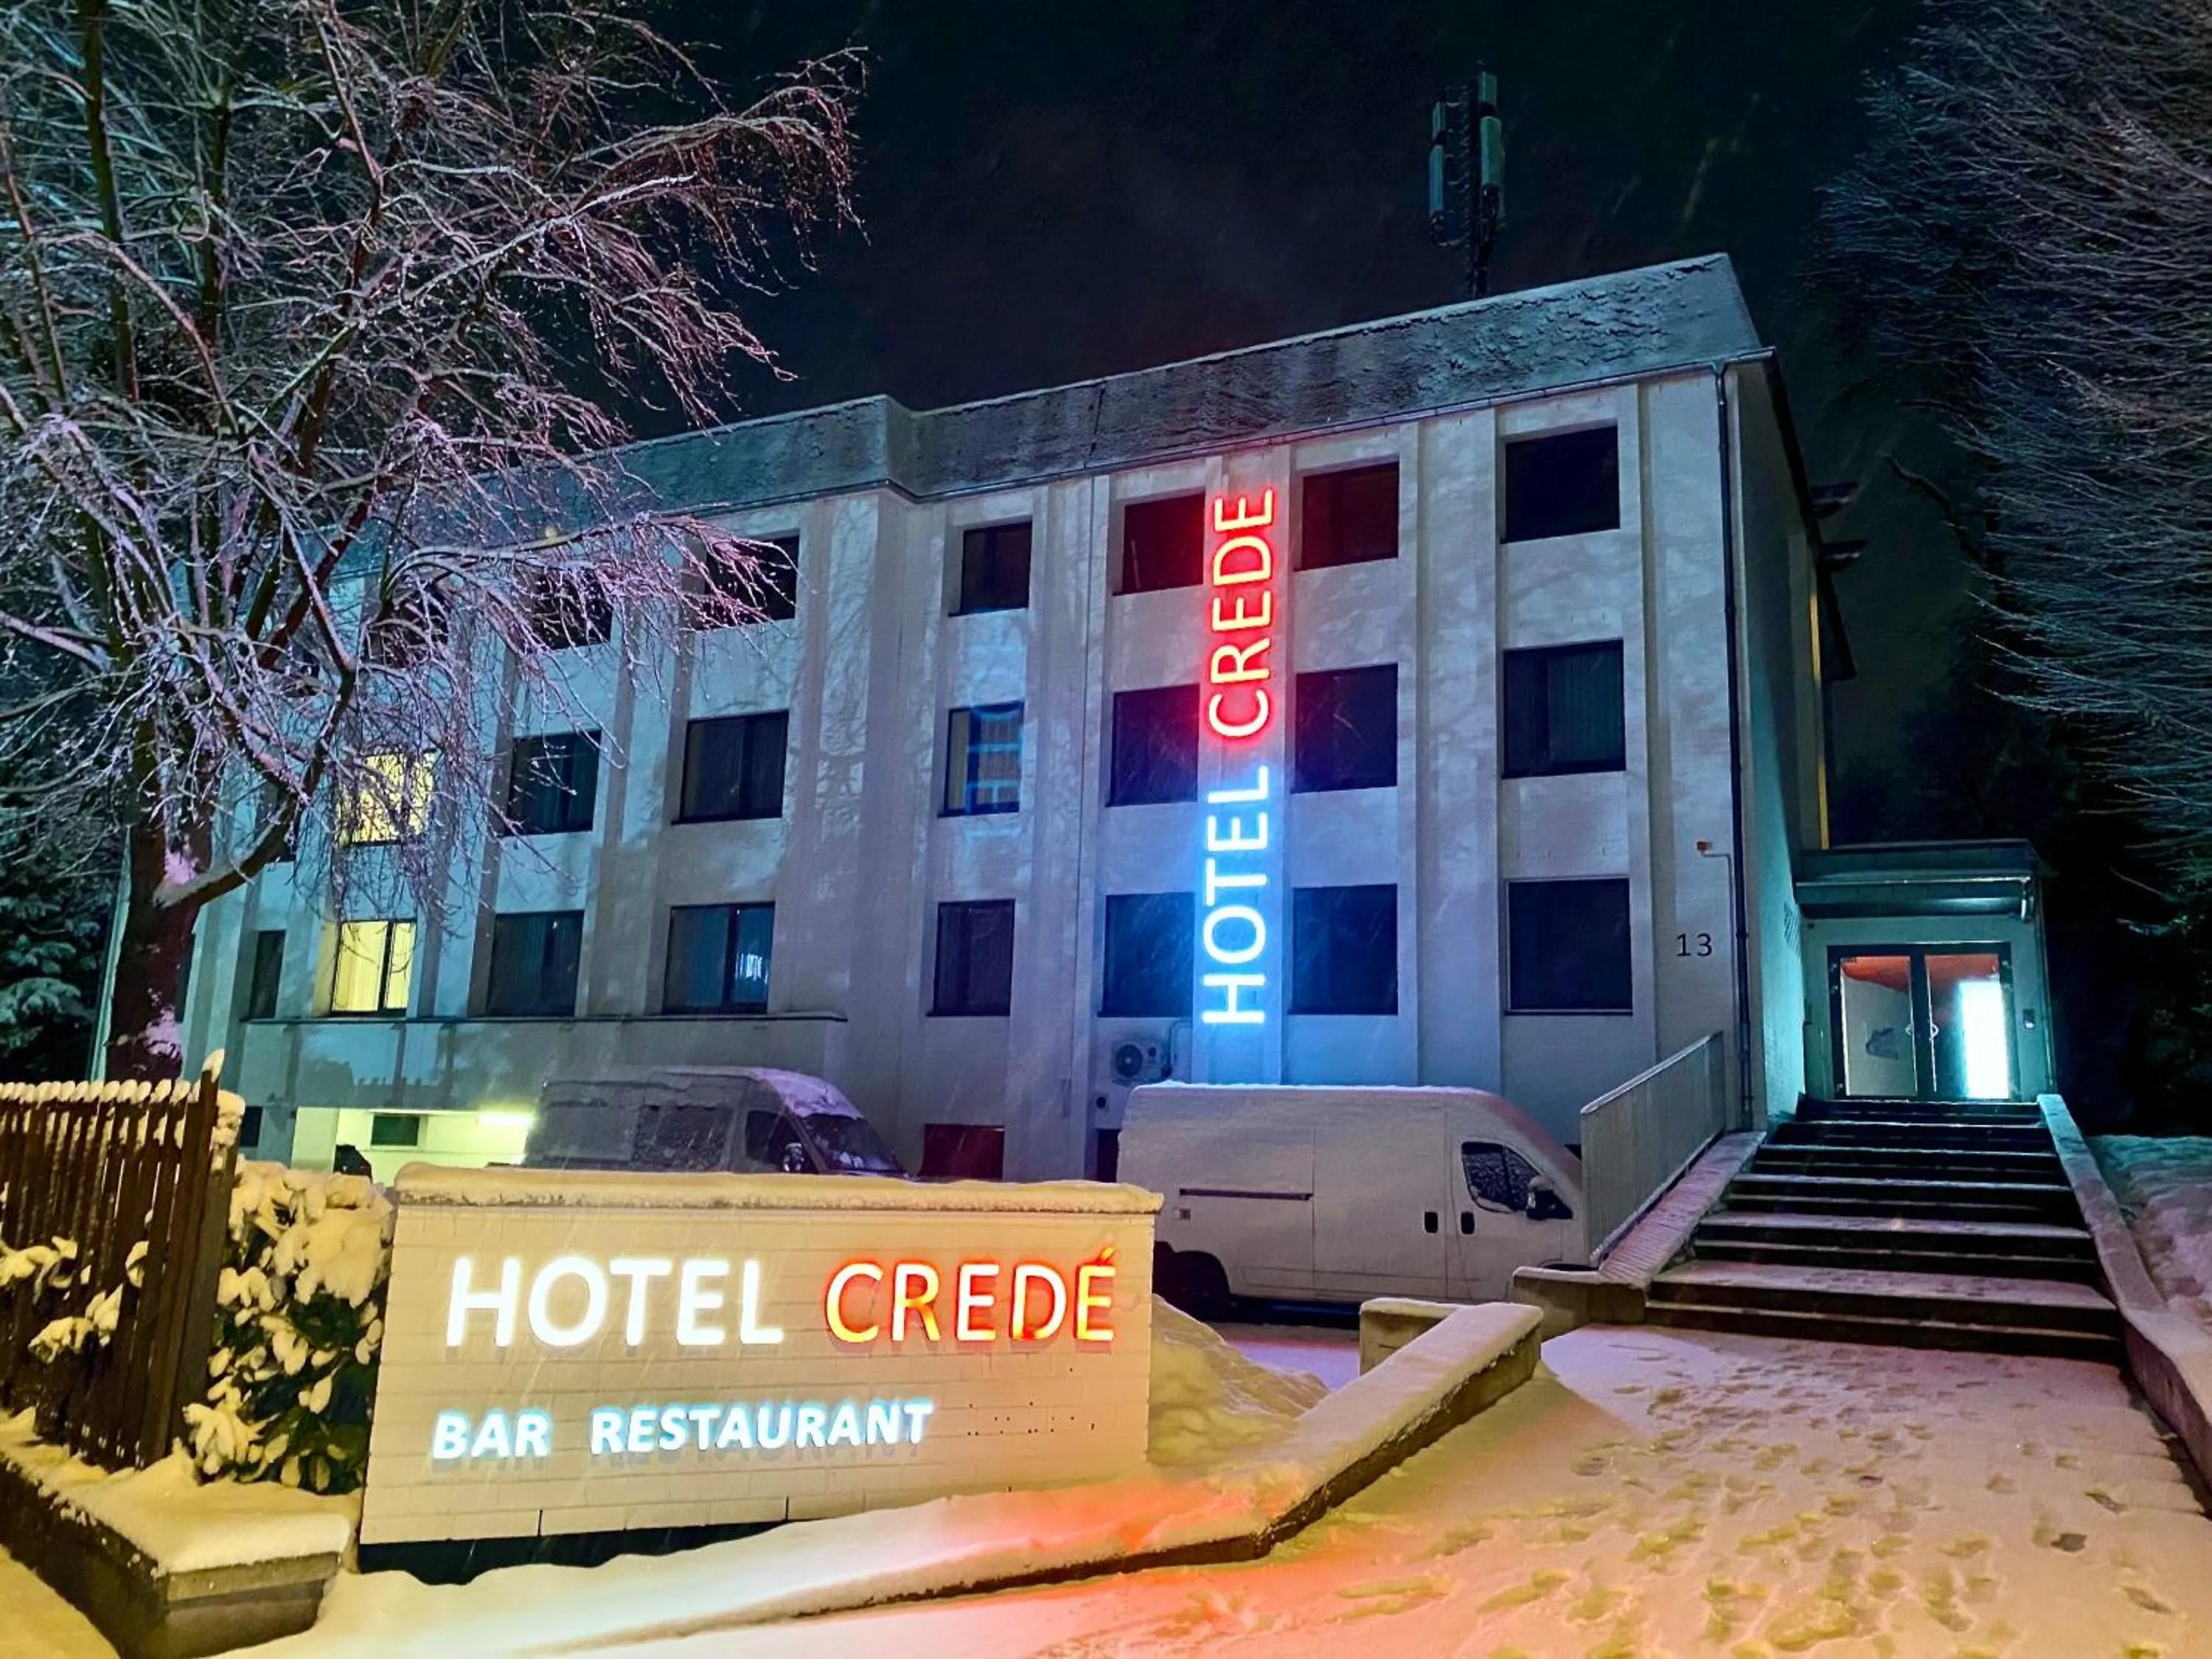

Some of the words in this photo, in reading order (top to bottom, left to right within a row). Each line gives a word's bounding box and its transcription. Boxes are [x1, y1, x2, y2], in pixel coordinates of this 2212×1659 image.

[1208, 489, 1273, 738] CREDE
[1202, 765, 1269, 1024] HOTEL
[1677, 933, 1713, 956] 13
[445, 1256, 784, 1347] HOTEL
[824, 1245, 1117, 1343] CREDÉ
[432, 1409, 550, 1460] BAR
[589, 1400, 935, 1455] RESTAURANT
